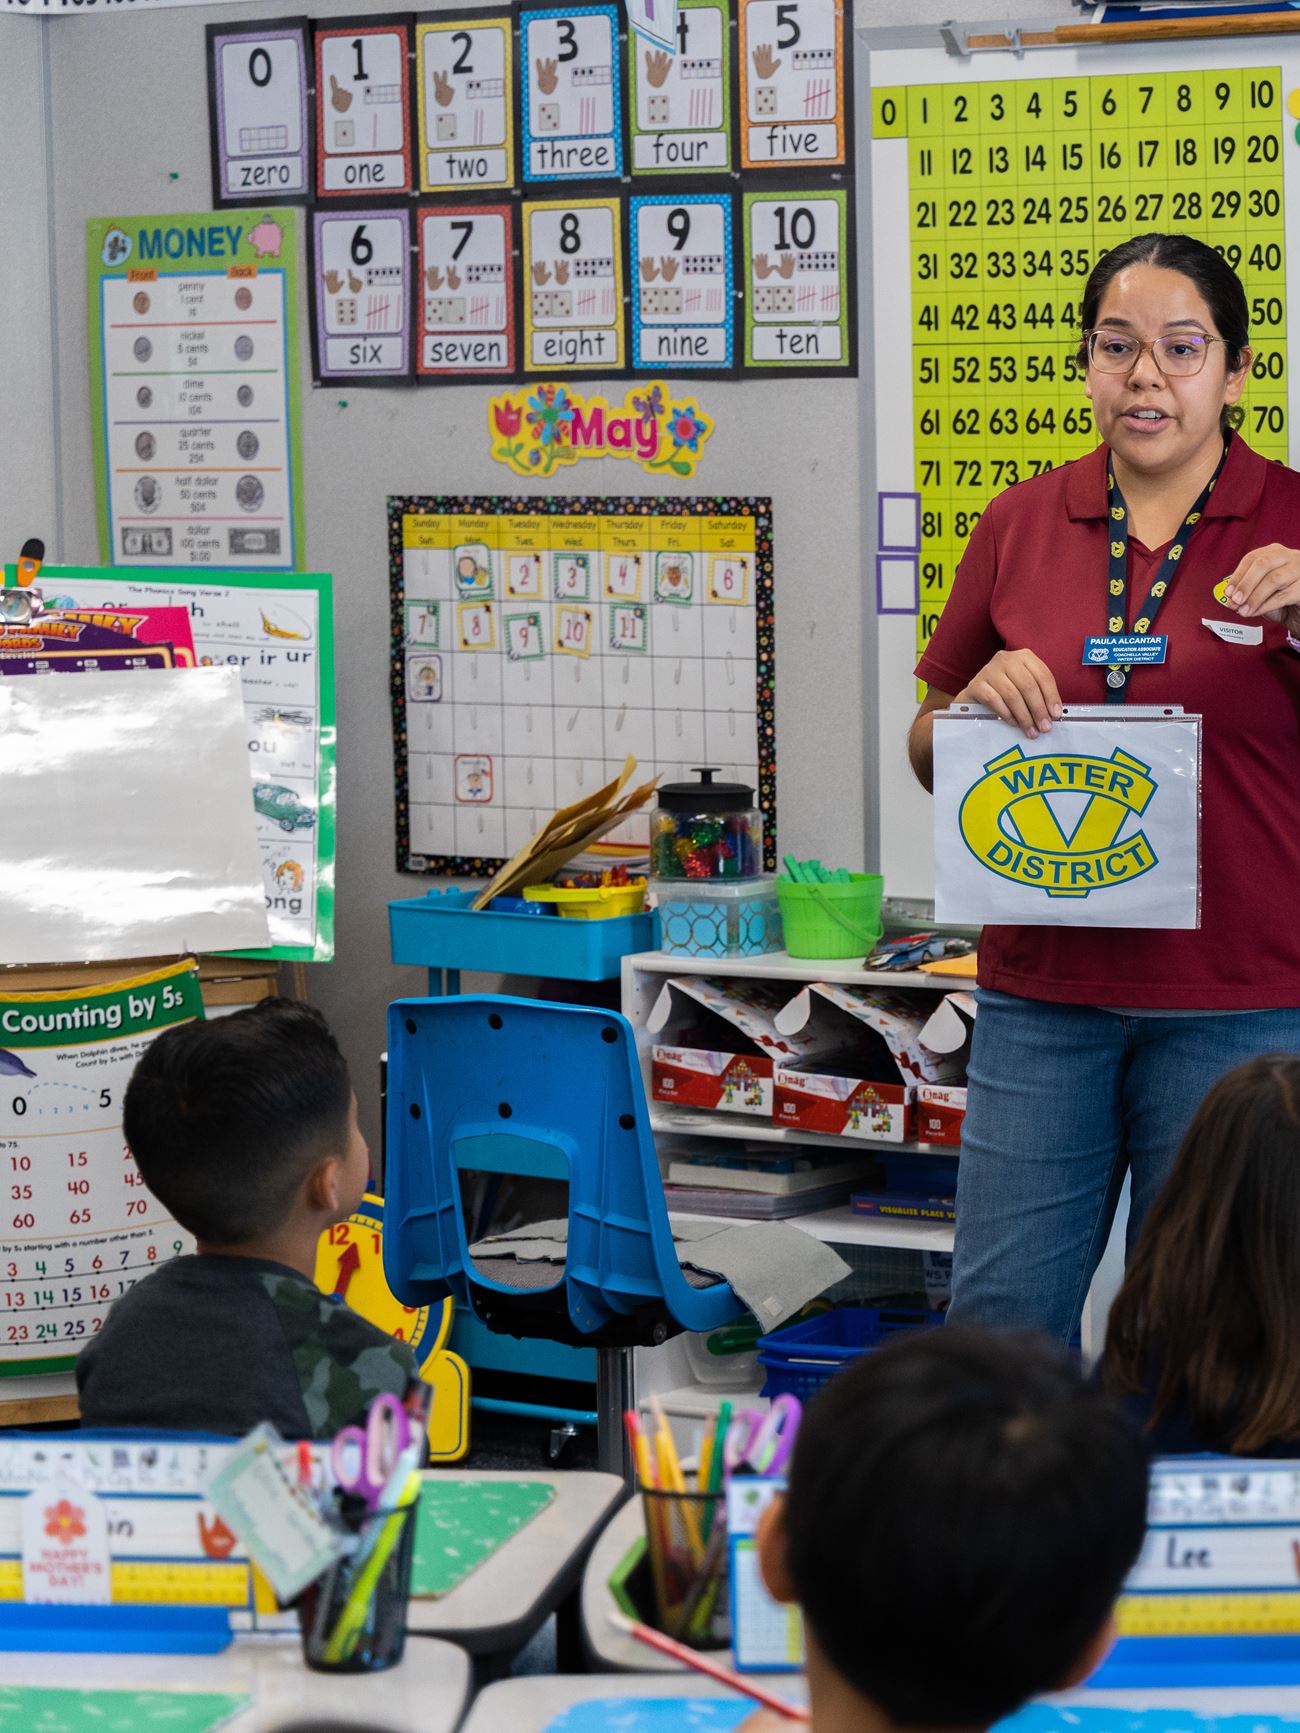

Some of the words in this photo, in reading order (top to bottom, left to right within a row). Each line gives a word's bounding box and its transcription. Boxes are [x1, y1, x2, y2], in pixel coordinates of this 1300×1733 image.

[555, 19, 579, 63] 3
[777, 4, 801, 50] 5
[249, 48, 272, 87] 0
[351, 38, 369, 82] 1
[450, 31, 474, 75] 2
[954, 95, 968, 123] 2
[990, 93, 1005, 121] 3
[1026, 91, 1042, 119] 4
[1063, 90, 1078, 118] 5
[1101, 88, 1117, 116] 6
[1138, 86, 1154, 114] 7
[1176, 84, 1192, 113] 8
[1215, 82, 1231, 111] 9
[1250, 80, 1274, 109] 10
[881, 98, 896, 126] 0
[652, 133, 709, 165] four
[766, 124, 820, 156] five
[1247, 134, 1279, 163] 20
[445, 154, 489, 179] two
[537, 141, 609, 169] three
[240, 165, 291, 187] zero
[344, 162, 386, 185] one
[135, 222, 246, 262] MONEY
[450, 220, 474, 262] 7
[559, 212, 582, 255] 8
[666, 207, 691, 251] 9
[773, 206, 816, 251] 10
[350, 224, 374, 267] 6
[1248, 243, 1282, 272] 40
[348, 334, 384, 365] six
[430, 341, 502, 363] seven
[543, 329, 607, 367] eight
[657, 328, 710, 357] nine
[774, 328, 821, 356] ten
[1251, 351, 1284, 380] 60
[569, 405, 662, 460] May
[1252, 405, 1284, 434] 70
[520, 564, 529, 585] 2
[724, 568, 733, 590] 6
[922, 562, 943, 589] 91
[565, 613, 585, 642] 10
[620, 614, 639, 639] 11
[1219, 627, 1244, 636] VISITOR
[285, 648, 312, 664] ur
[1000, 761, 1136, 800] WATER
[985, 839, 1149, 886] DISTRICT
[2, 1005, 122, 1033] Counting
[128, 995, 156, 1020] by
[163, 985, 183, 1009] 5s
[10, 1155, 32, 1172] 10
[67, 1151, 89, 1168] 15
[66, 1179, 91, 1196] 40
[11, 1212, 36, 1229] 60
[68, 1207, 92, 1225] 65
[125, 1199, 148, 1217] 70
[328, 1224, 351, 1246] 12
[1166, 1534, 1212, 1570] Lee
